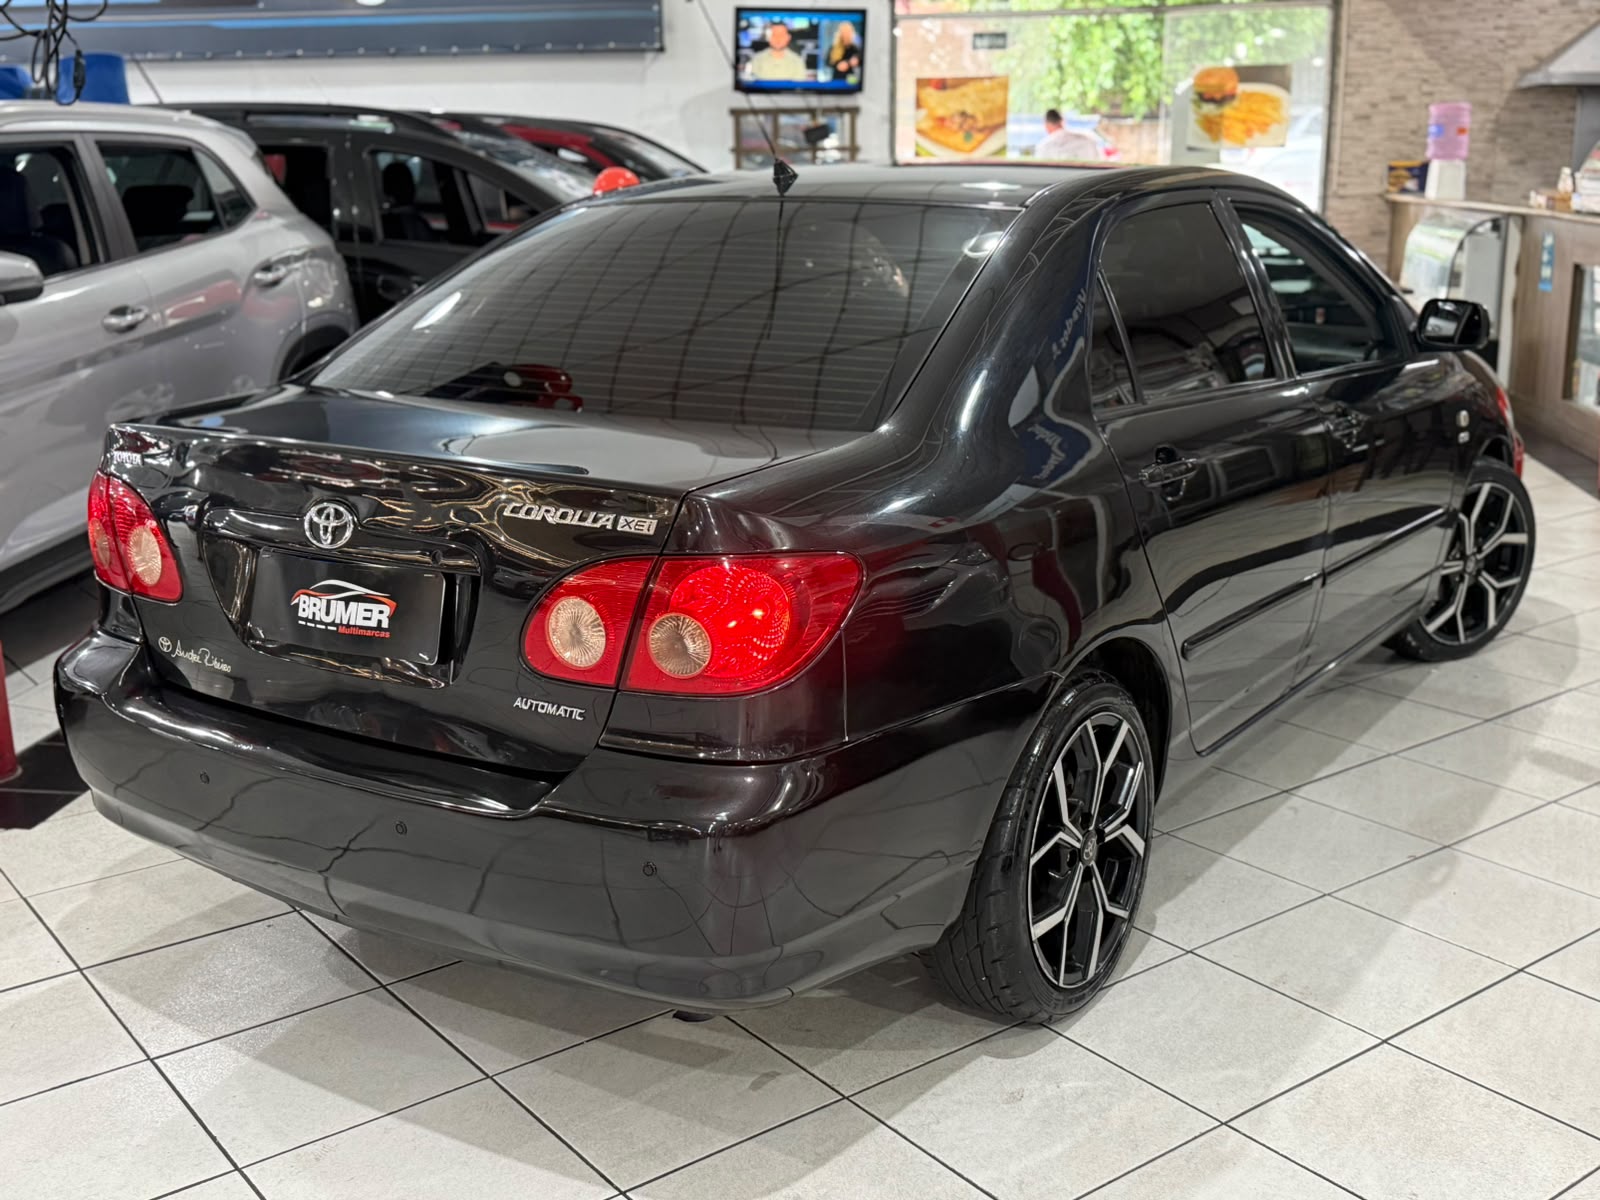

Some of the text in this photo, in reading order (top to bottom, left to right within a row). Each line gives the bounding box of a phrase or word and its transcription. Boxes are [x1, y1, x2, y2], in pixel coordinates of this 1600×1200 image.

[112, 450, 143, 467] TOYOTA
[503, 502, 616, 530] COROLLA
[298, 594, 391, 628] BRUMER
[337, 625, 391, 638] Multimarcas
[513, 697, 586, 720] AUTOMATIC
